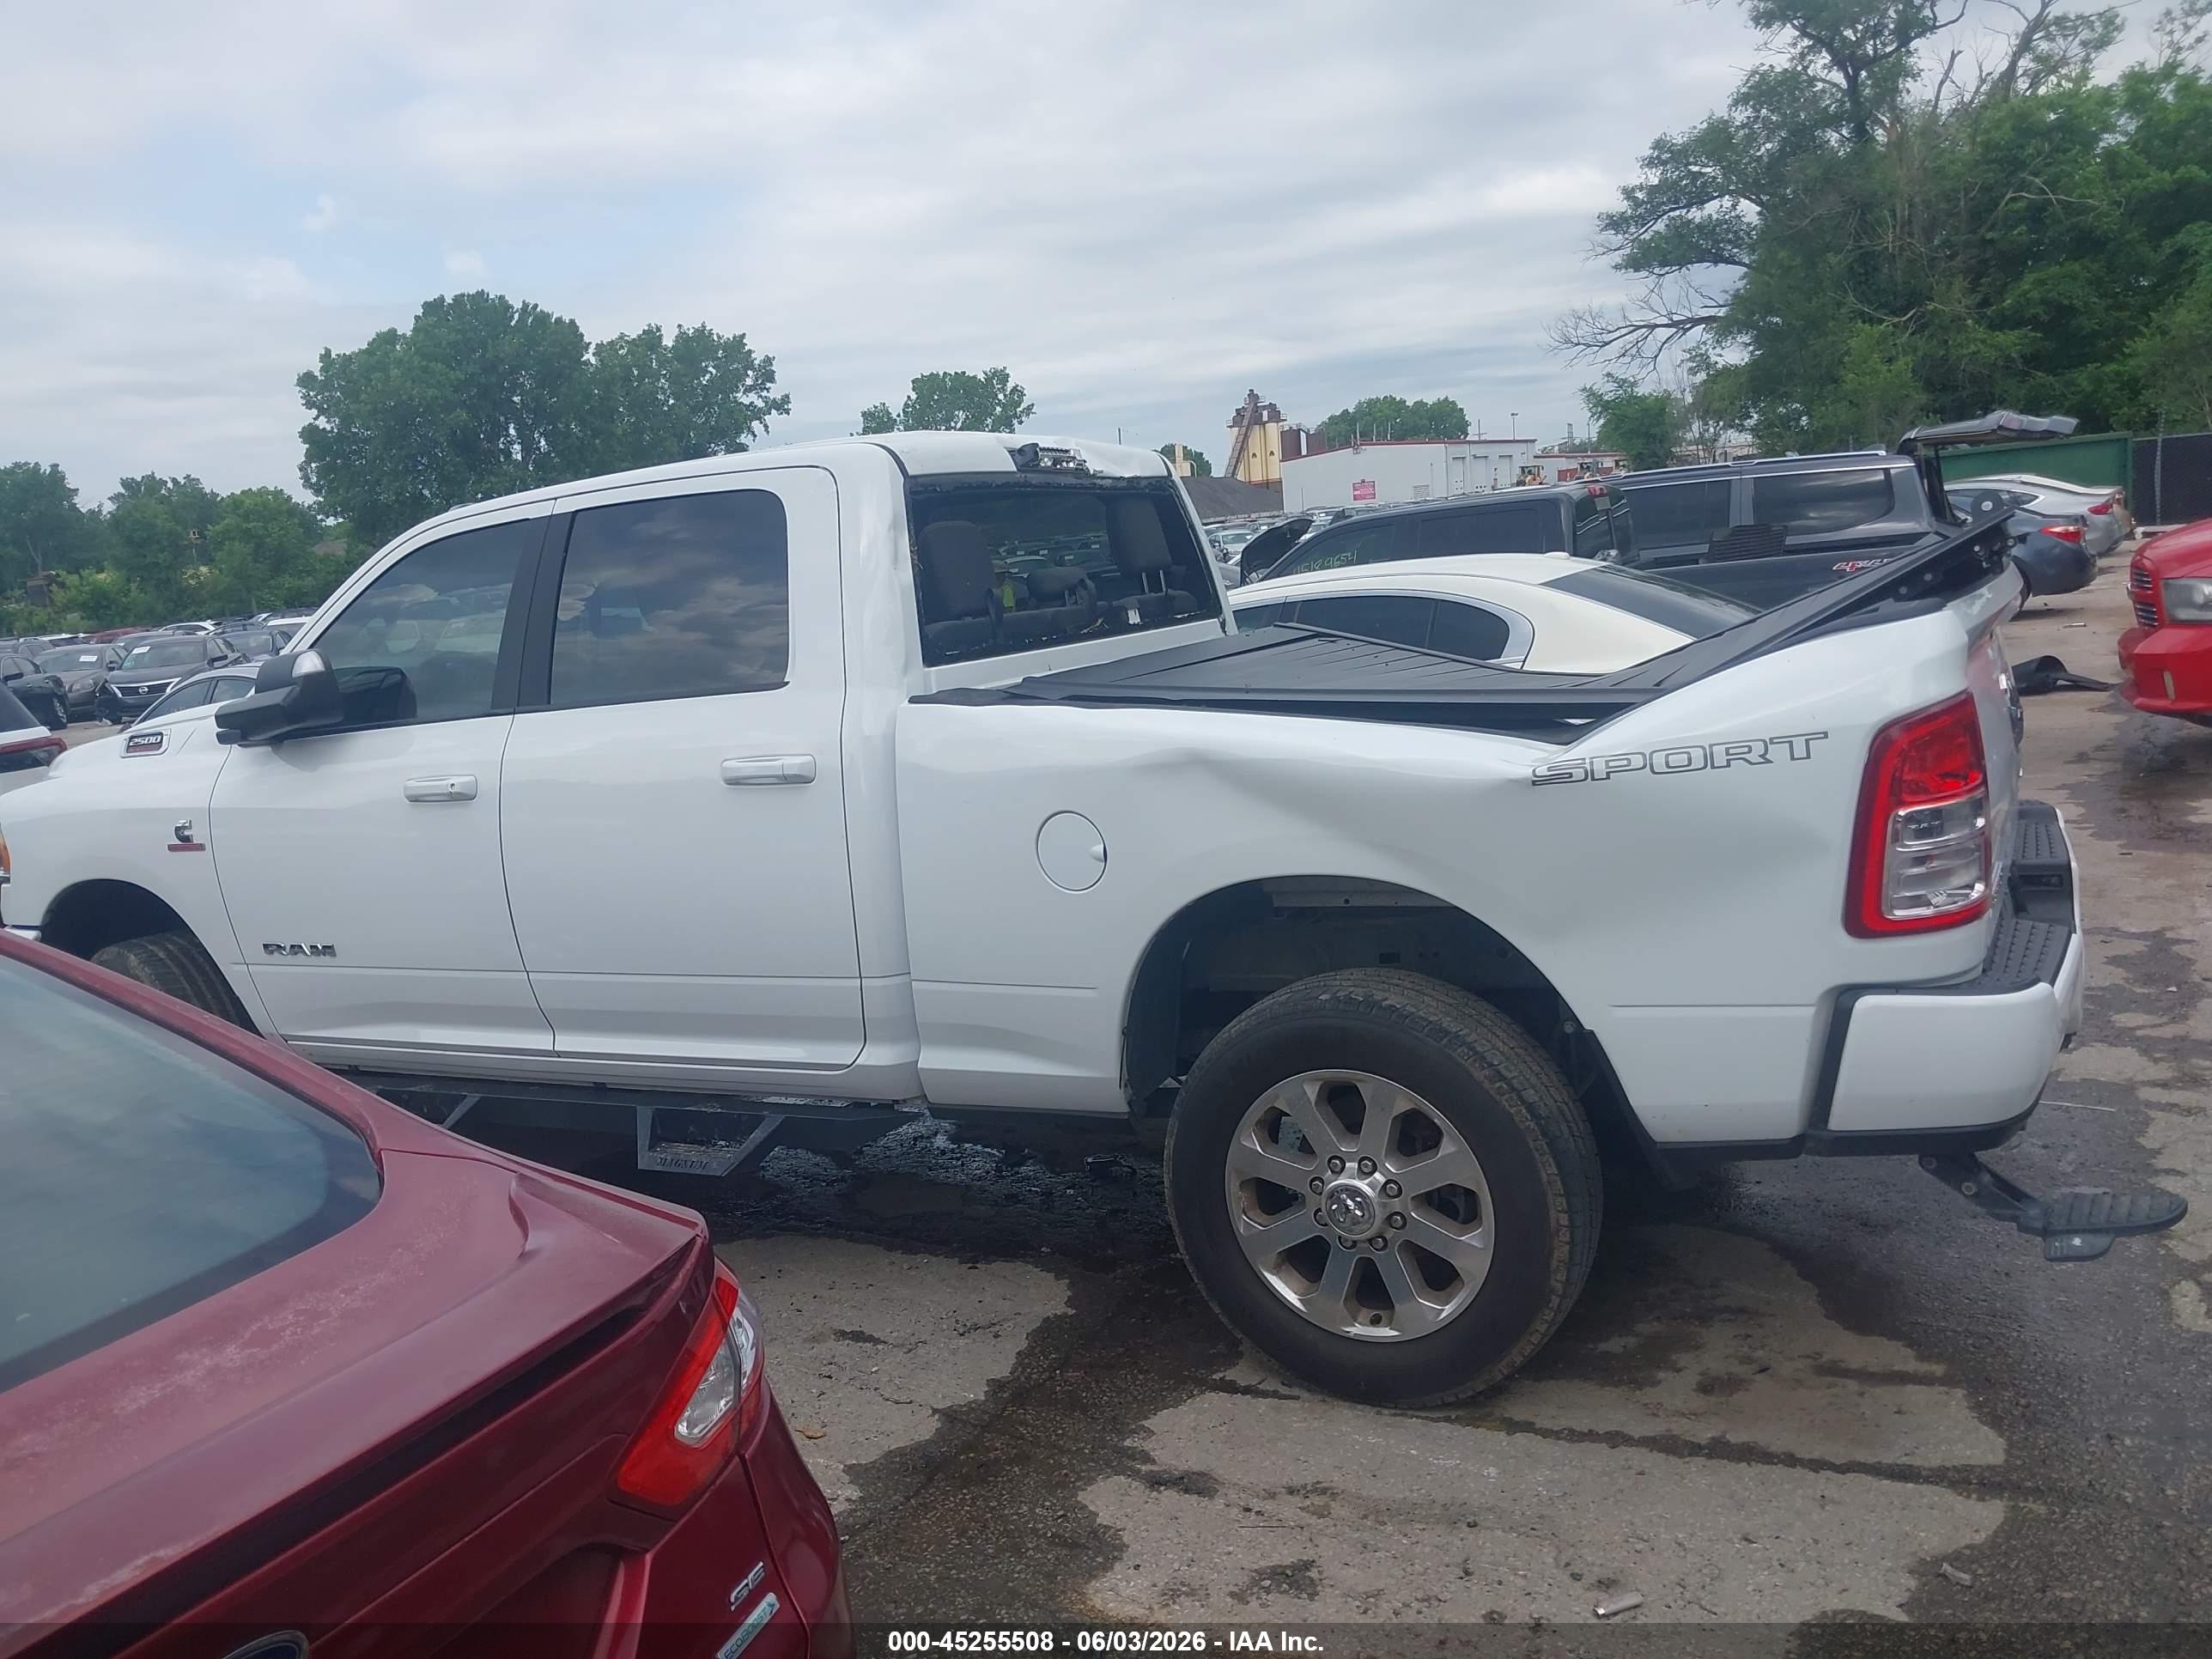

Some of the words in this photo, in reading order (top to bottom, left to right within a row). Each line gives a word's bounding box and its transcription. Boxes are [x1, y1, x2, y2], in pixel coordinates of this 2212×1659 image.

[129, 736, 161, 746] 2500
[1531, 731, 1829, 787] SPORT
[262, 943, 337, 957] RAM
[656, 1157, 709, 1170] MAGNUM
[730, 1561, 765, 1611] SE
